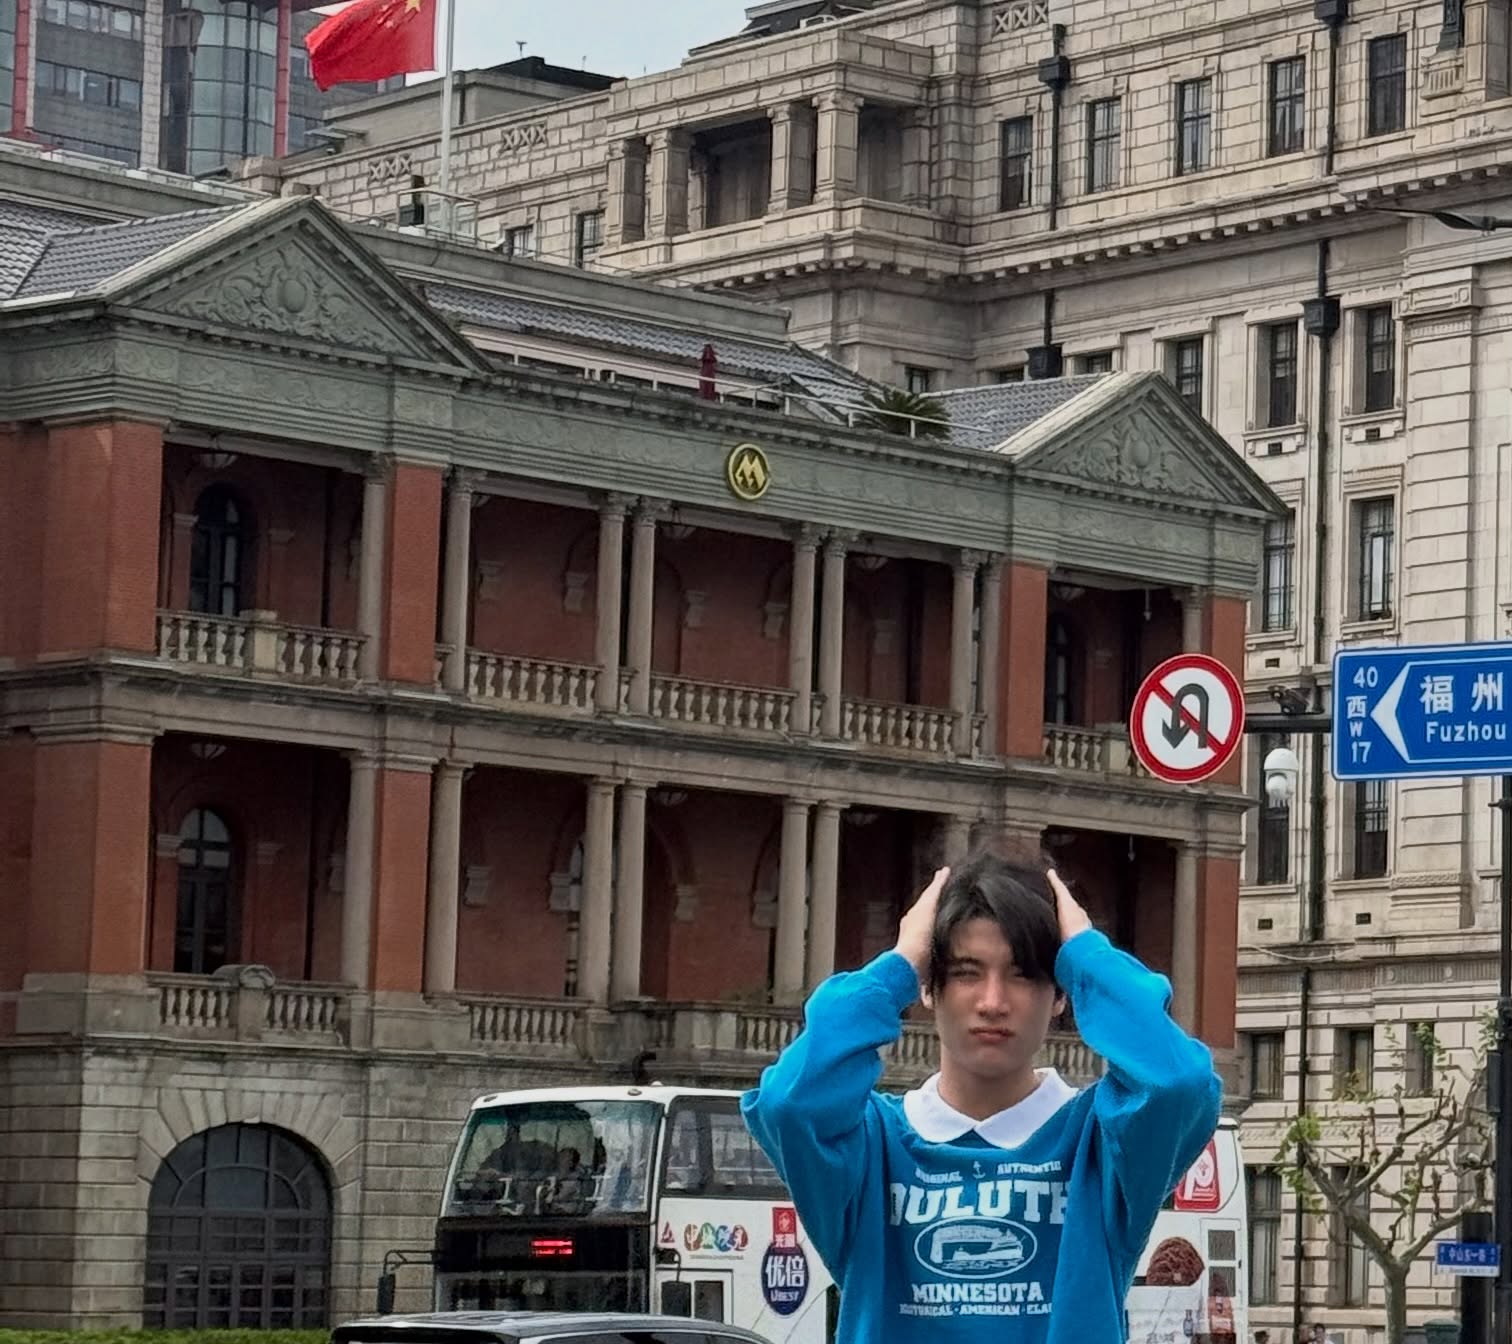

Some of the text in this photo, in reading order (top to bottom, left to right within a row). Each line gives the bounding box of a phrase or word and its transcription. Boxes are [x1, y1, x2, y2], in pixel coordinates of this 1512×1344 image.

[1353, 666, 1379, 689] 40
[1346, 695, 1367, 720] 西
[1348, 721, 1364, 737] W
[1425, 720, 1507, 743] Fuzhou
[1351, 741, 1372, 765] 17
[765, 1255, 805, 1288] 优倍
[911, 1281, 1044, 1304] MINNESOTA
[959, 1303, 1020, 1316] AMERICAN
